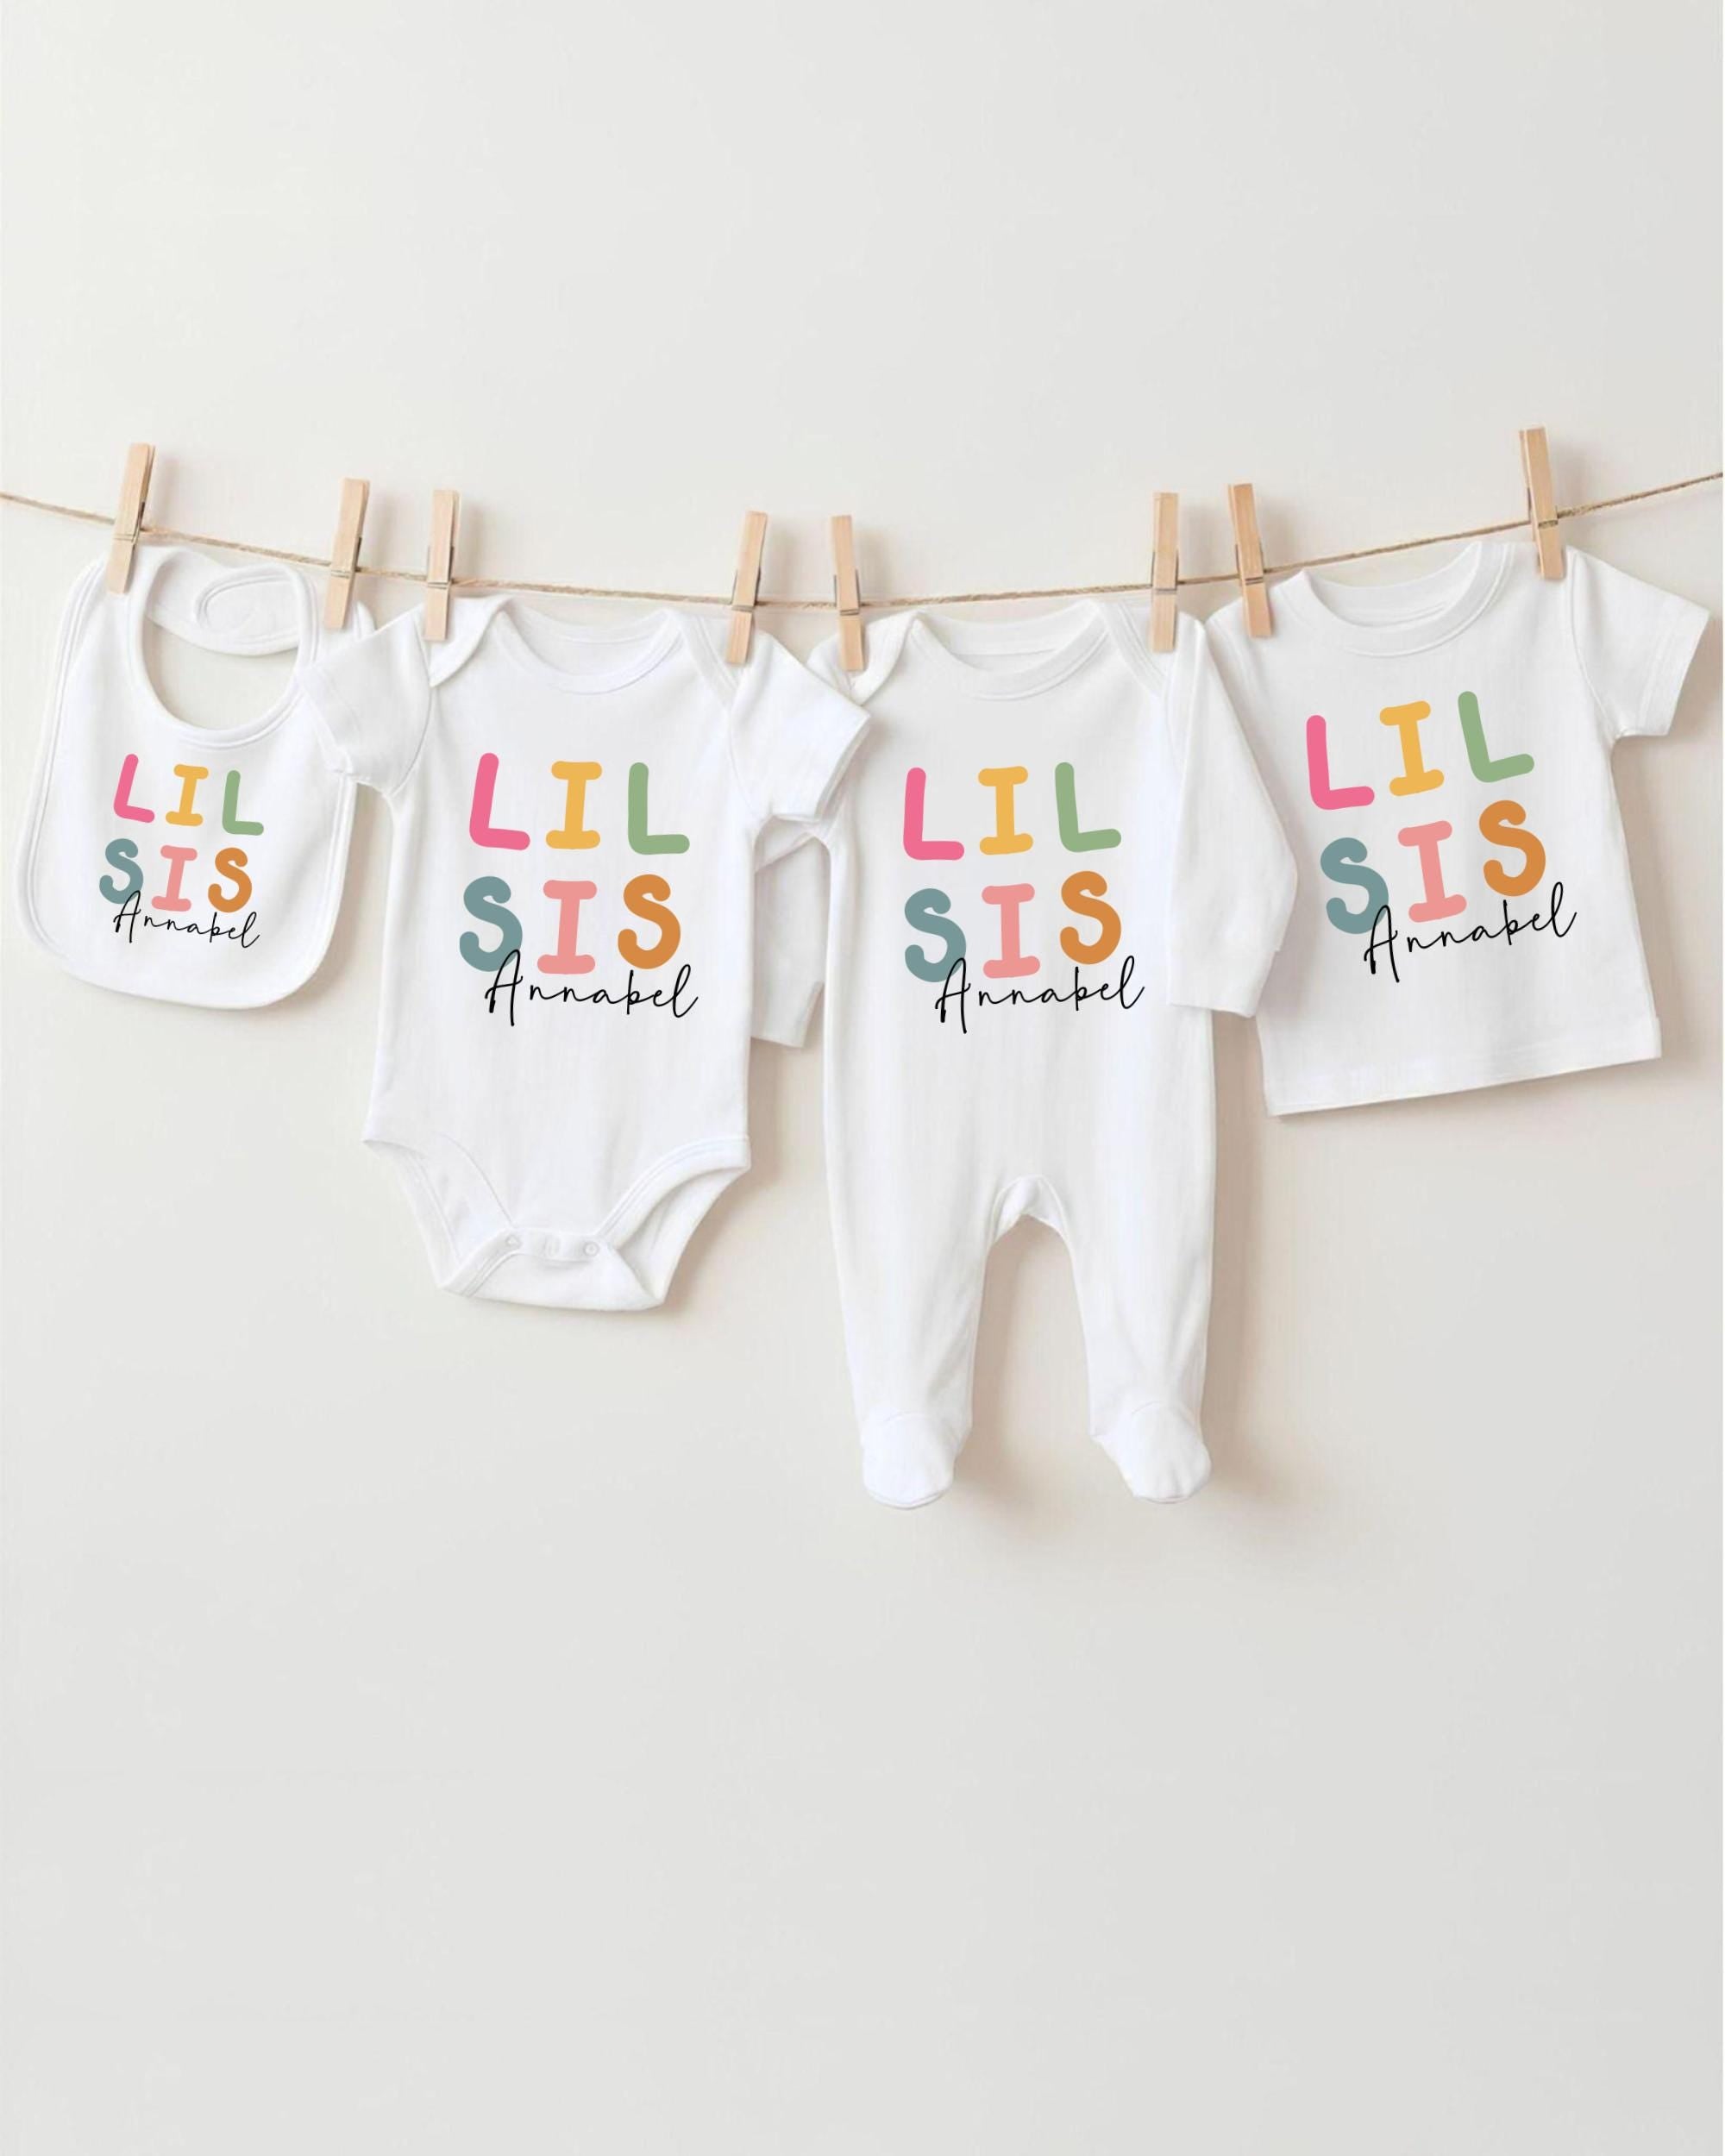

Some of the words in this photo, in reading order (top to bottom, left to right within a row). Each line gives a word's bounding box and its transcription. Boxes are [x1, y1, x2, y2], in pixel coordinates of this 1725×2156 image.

[113, 754, 264, 837] LIL
[1305, 690, 1535, 812] LIL
[468, 752, 690, 855] LIL
[902, 762, 1122, 862] LIL
[99, 838, 253, 913] SIS
[1320, 799, 1546, 935] SIS
[113, 889, 260, 949] Annabel
[459, 874, 681, 975] SIS
[904, 870, 1122, 982] SIS
[1362, 881, 1578, 984] Annabel
[484, 948, 699, 1027] Annabel
[934, 955, 1145, 1035] Annabel
